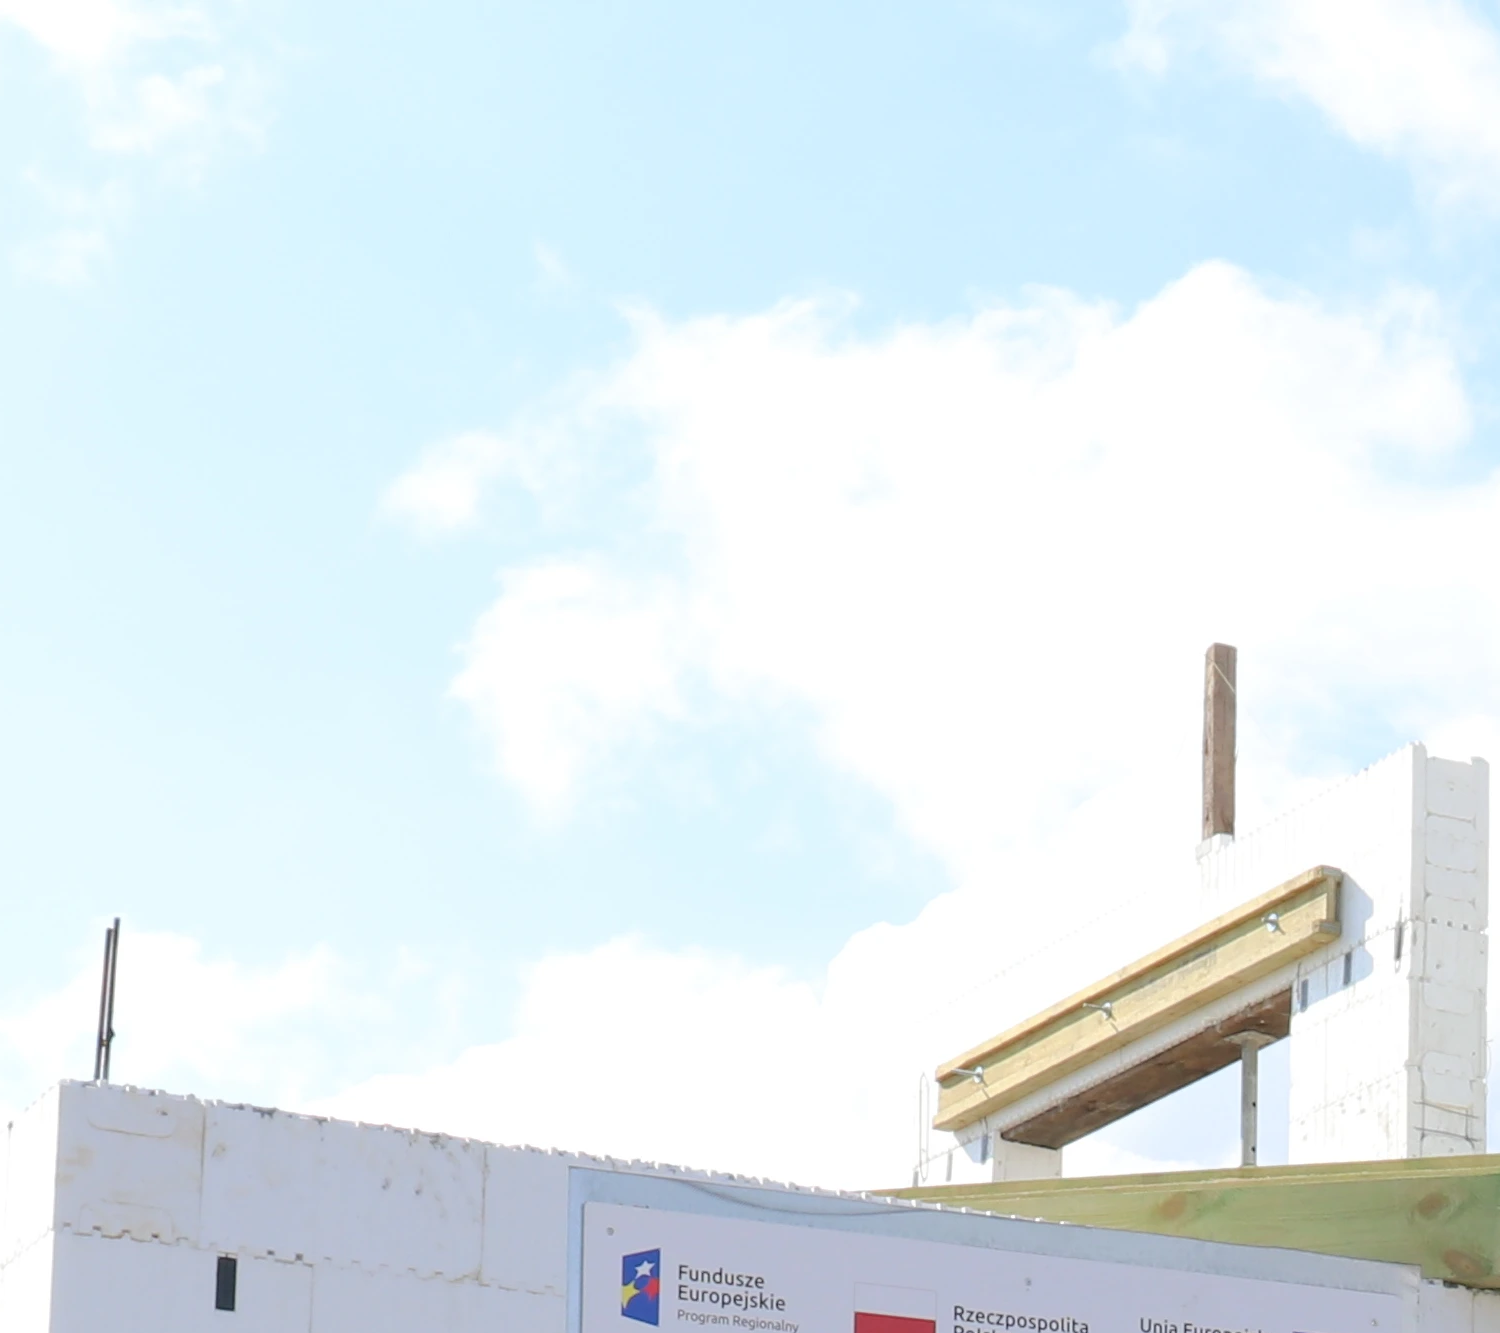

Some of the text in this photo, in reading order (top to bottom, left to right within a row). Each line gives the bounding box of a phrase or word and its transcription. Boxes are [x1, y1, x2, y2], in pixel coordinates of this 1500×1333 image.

[677, 1263, 766, 1290] Fundusze
[677, 1283, 787, 1312] Europejskie
[676, 1308, 730, 1326] Program
